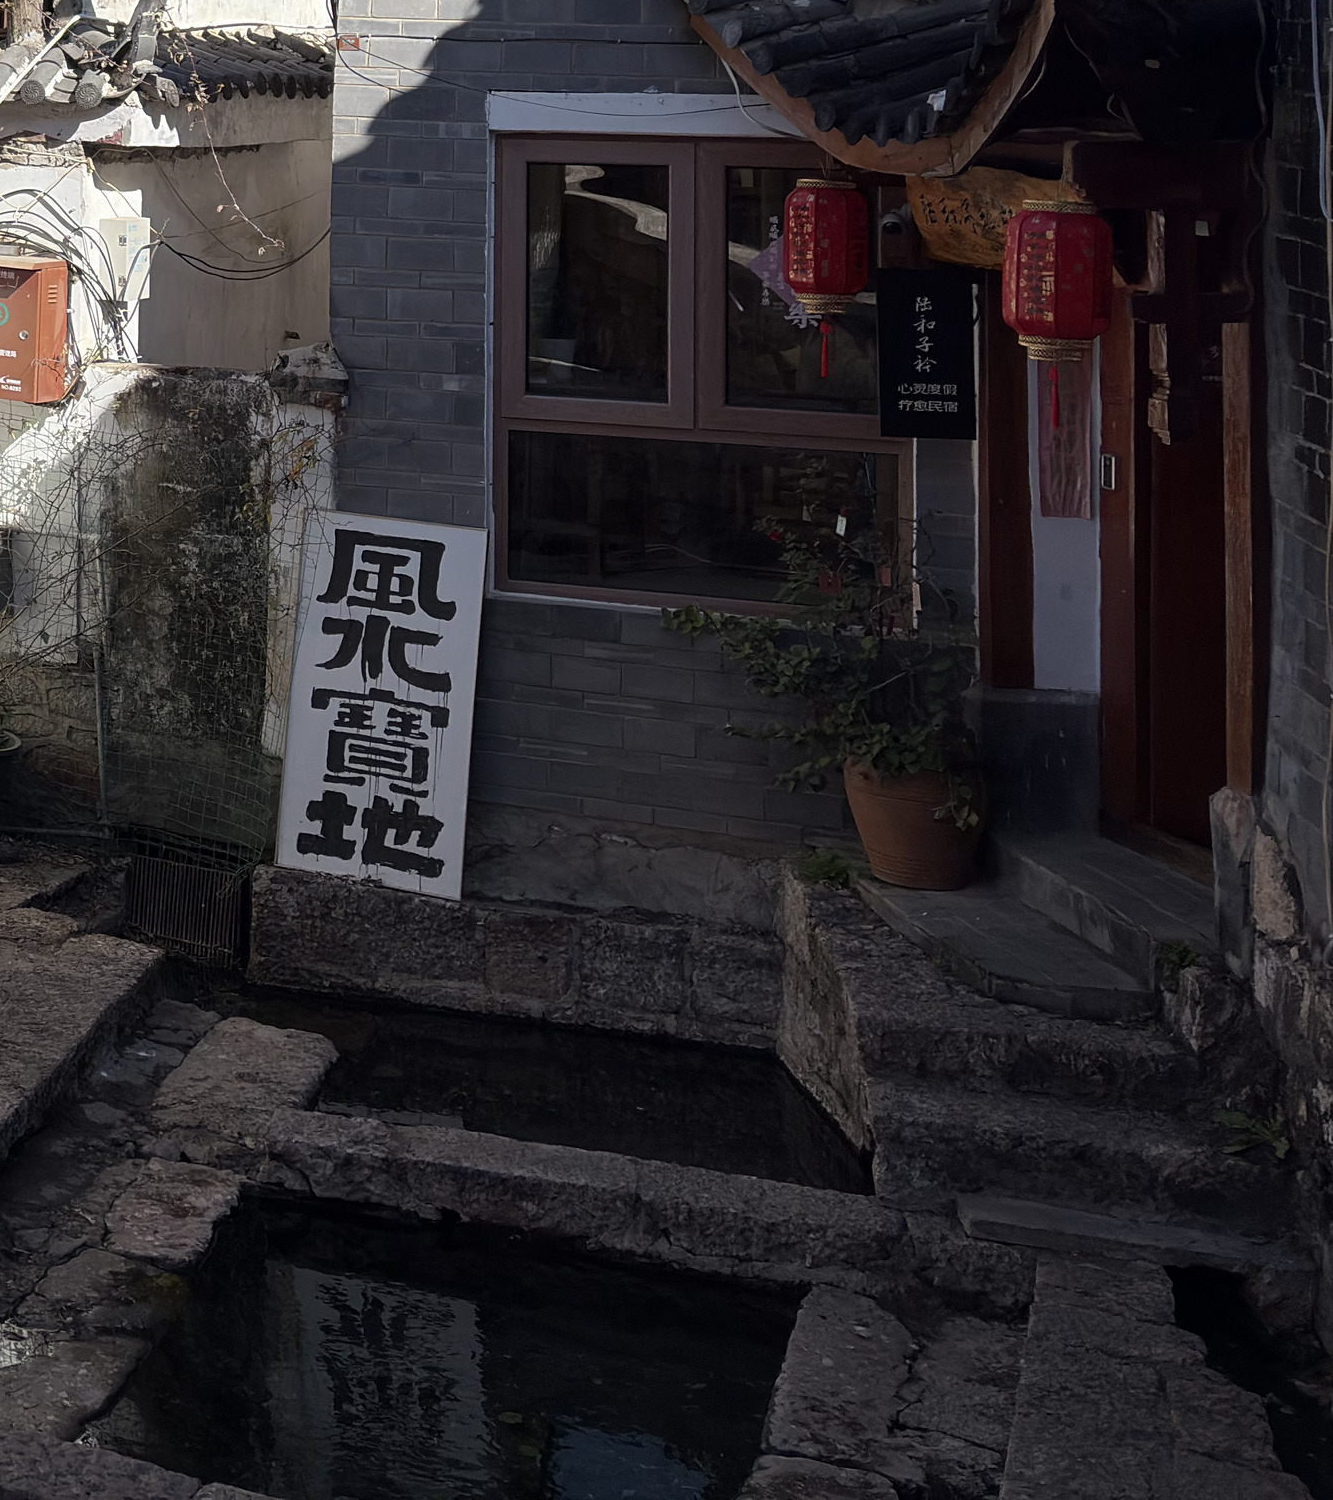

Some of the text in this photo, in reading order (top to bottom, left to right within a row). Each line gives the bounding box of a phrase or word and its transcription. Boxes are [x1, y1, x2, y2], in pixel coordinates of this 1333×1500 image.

[913, 296, 937, 373] 陆和子衿
[897, 383, 958, 395] 心灵度假
[898, 400, 958, 413] 疗愈民宿
